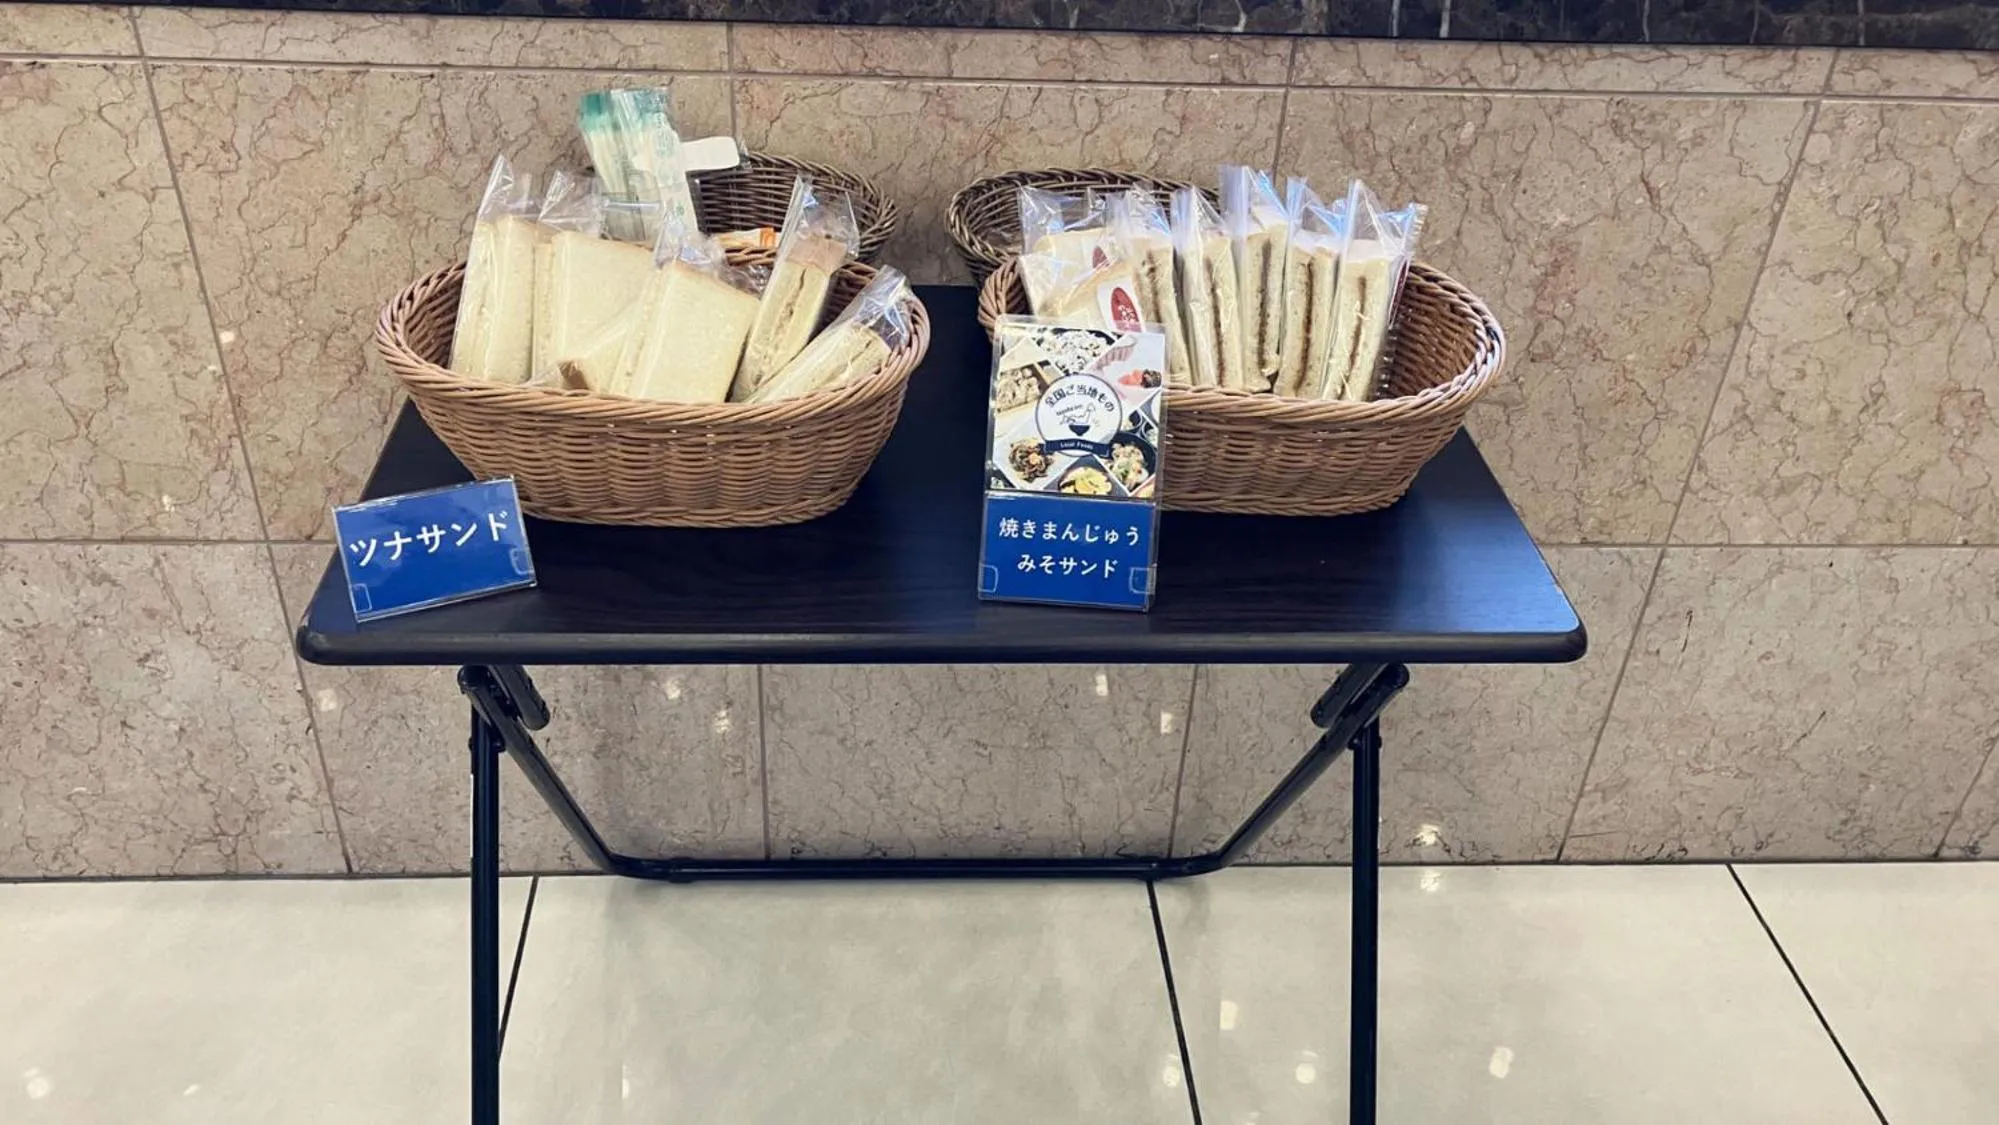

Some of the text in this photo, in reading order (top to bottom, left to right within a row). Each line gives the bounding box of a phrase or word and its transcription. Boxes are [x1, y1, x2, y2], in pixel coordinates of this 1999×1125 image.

[1045, 384, 1115, 412] 全国ご当地もの
[350, 511, 508, 567] ツナサンド
[999, 516, 1140, 546] 焼きまんじゅう
[1017, 554, 1118, 579] みそサンド
